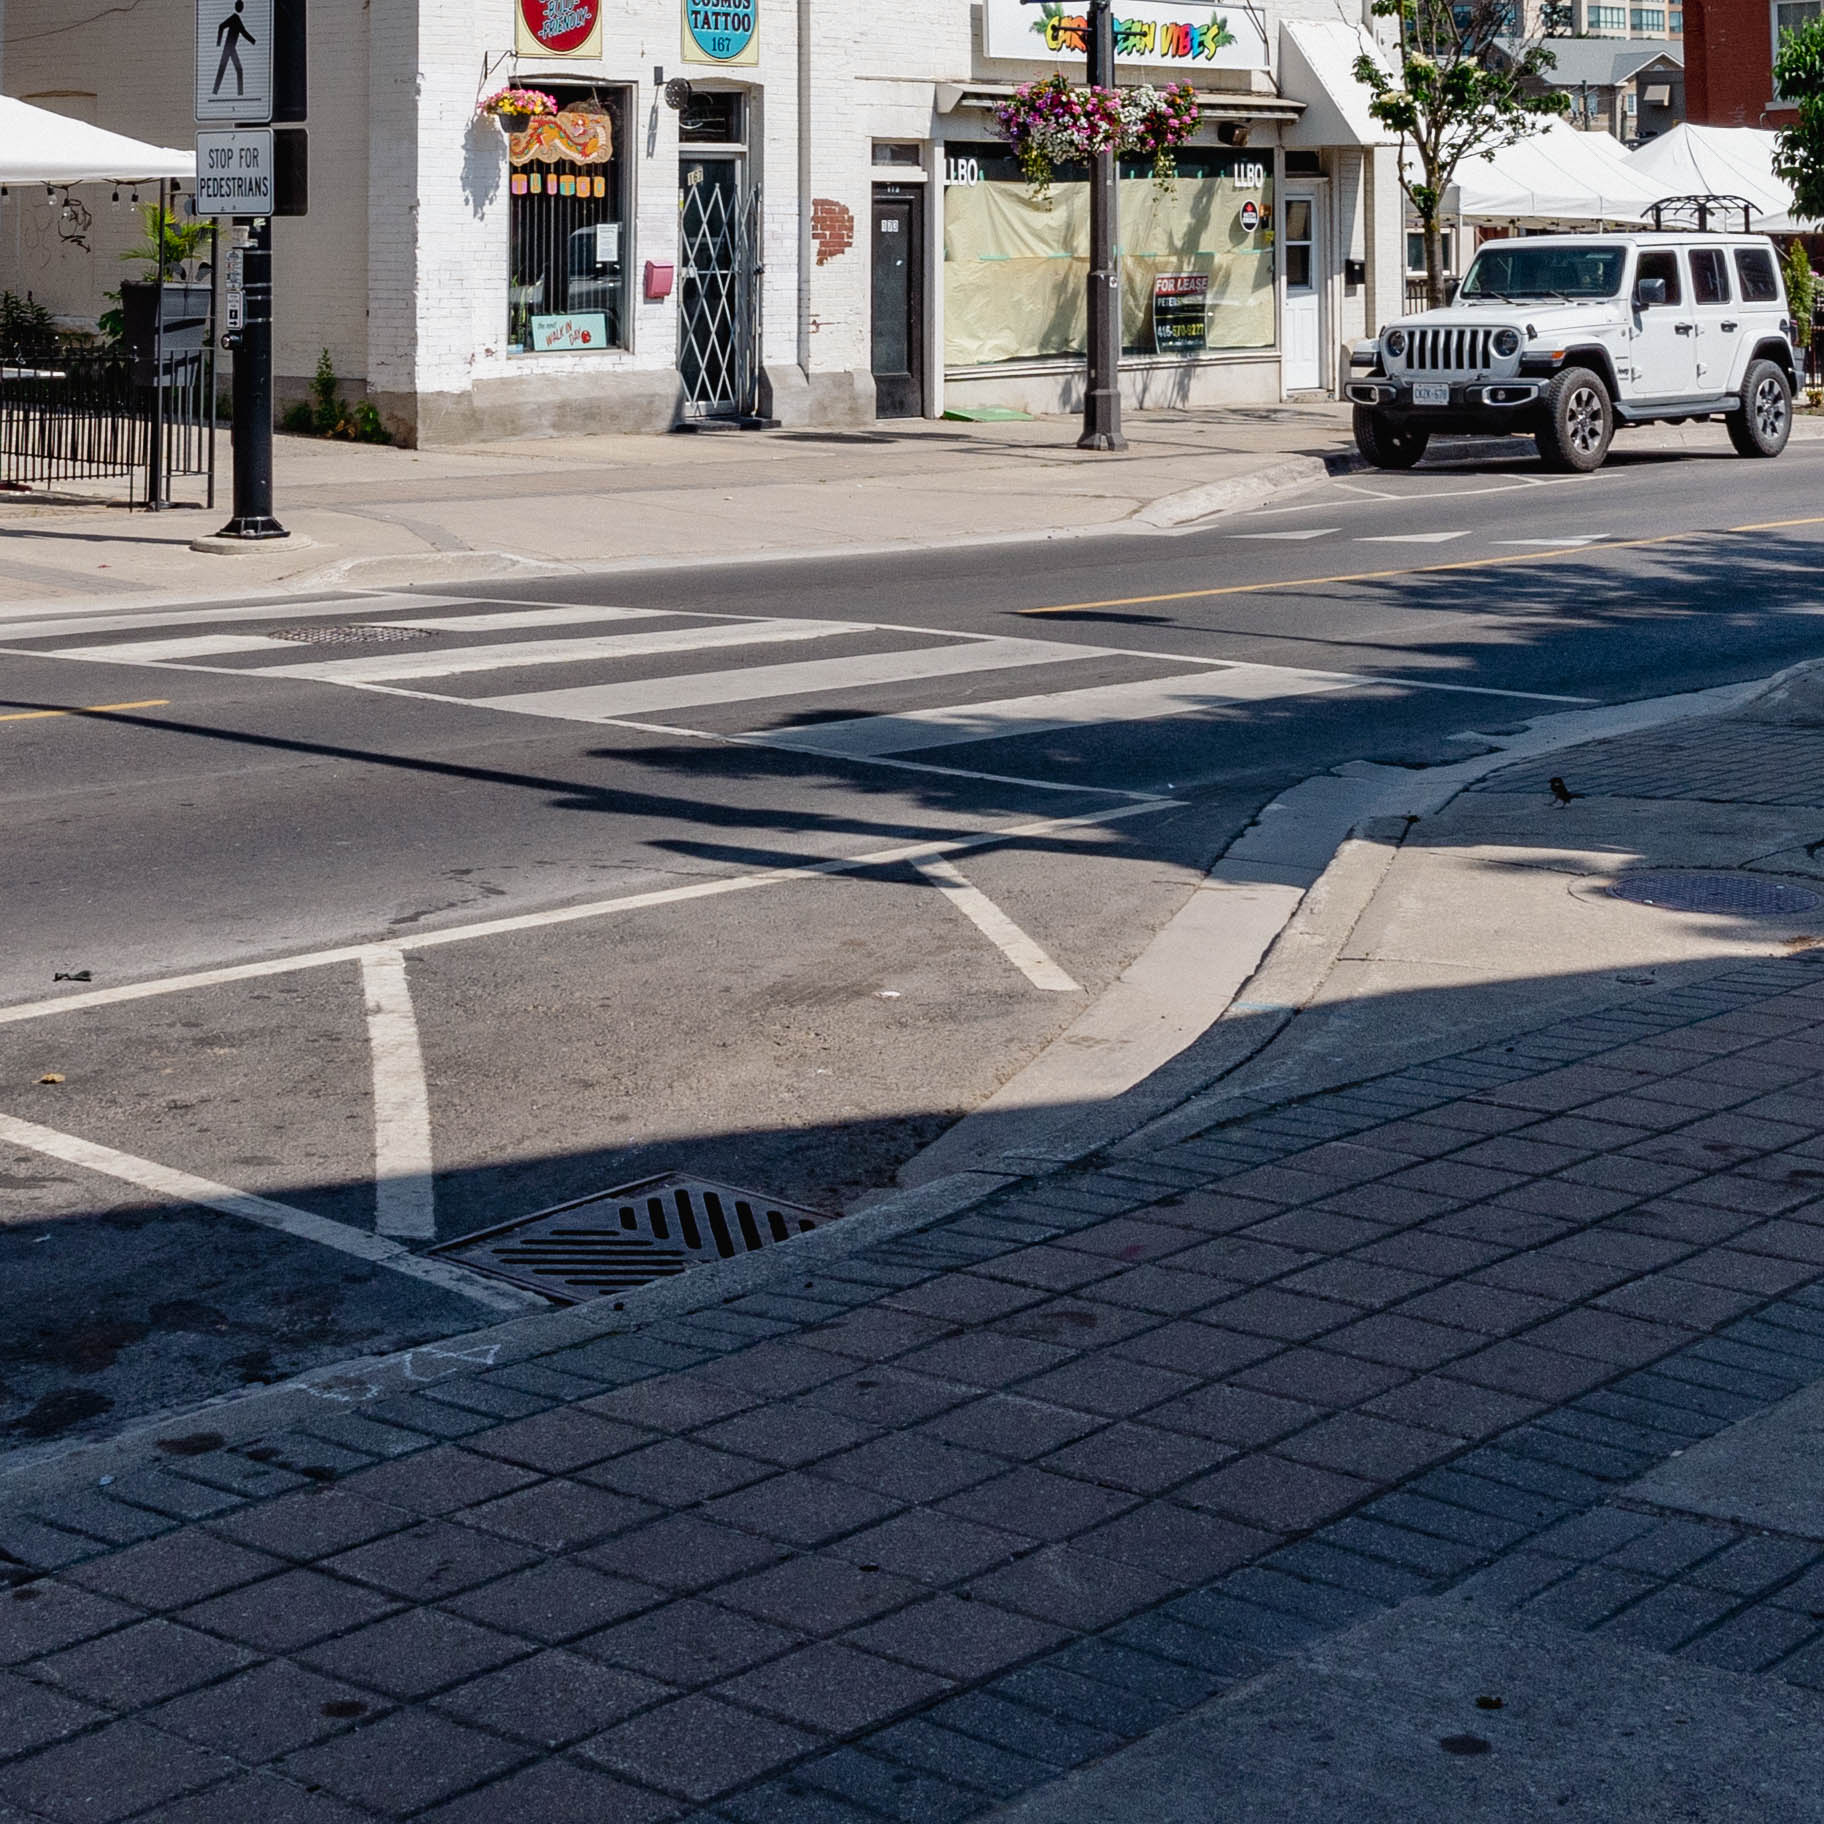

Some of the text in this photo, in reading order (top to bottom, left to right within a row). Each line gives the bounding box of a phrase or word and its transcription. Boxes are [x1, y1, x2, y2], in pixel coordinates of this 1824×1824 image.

[691, 9, 752, 32] TATTOO
[712, 37, 732, 52] 167
[1160, 22, 1219, 61] VIBES
[208, 147, 260, 169] STOP FOR
[943, 158, 978, 187] LLBO
[1234, 163, 1264, 188] LLBO
[200, 177, 269, 198] PEDESTRIANS
[1156, 277, 1208, 292] FOR LEASE
